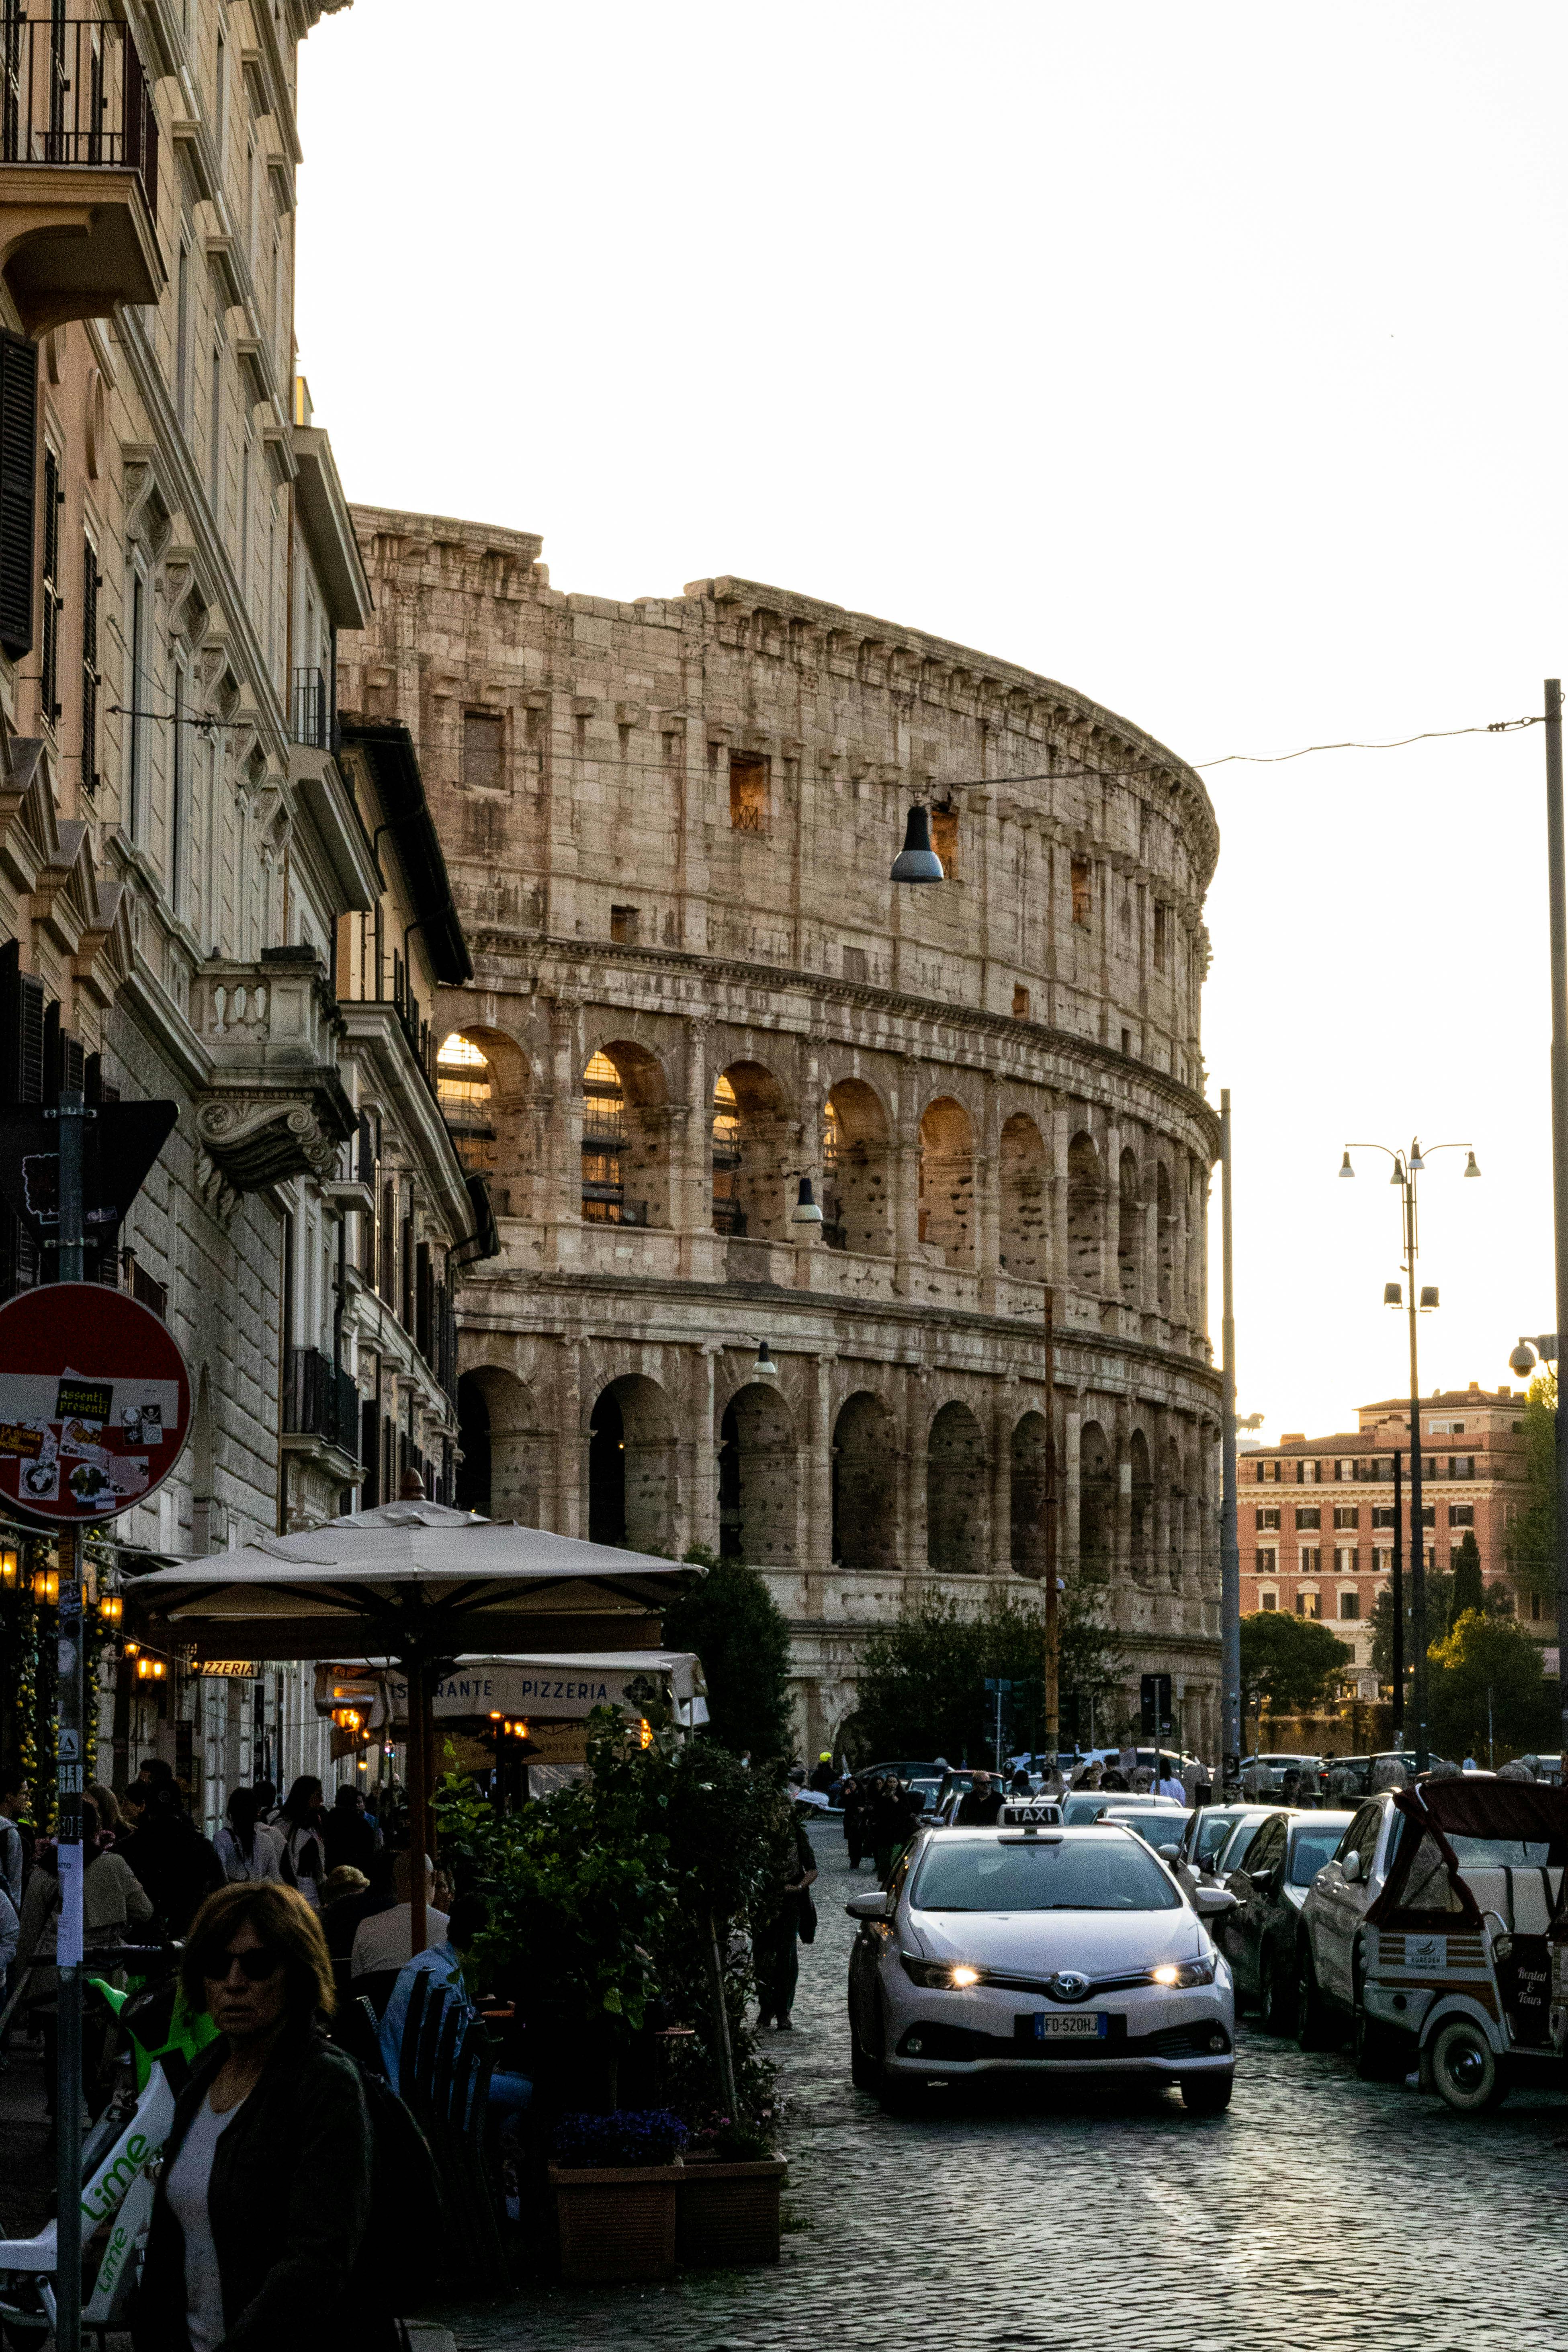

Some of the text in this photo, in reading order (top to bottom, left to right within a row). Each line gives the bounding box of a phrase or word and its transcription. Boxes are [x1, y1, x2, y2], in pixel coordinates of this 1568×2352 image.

[59, 1400, 107, 1415] presenti
[523, 1681, 607, 1699] PIZZERIA
[1010, 1808, 1052, 1822] TAXI
[1517, 1966, 1547, 1982] Rental
[1527, 1981, 1535, 1993] &
[1517, 1991, 1542, 2006] Tours
[81, 2134, 150, 2220] Lime
[98, 2227, 127, 2293] Lime
